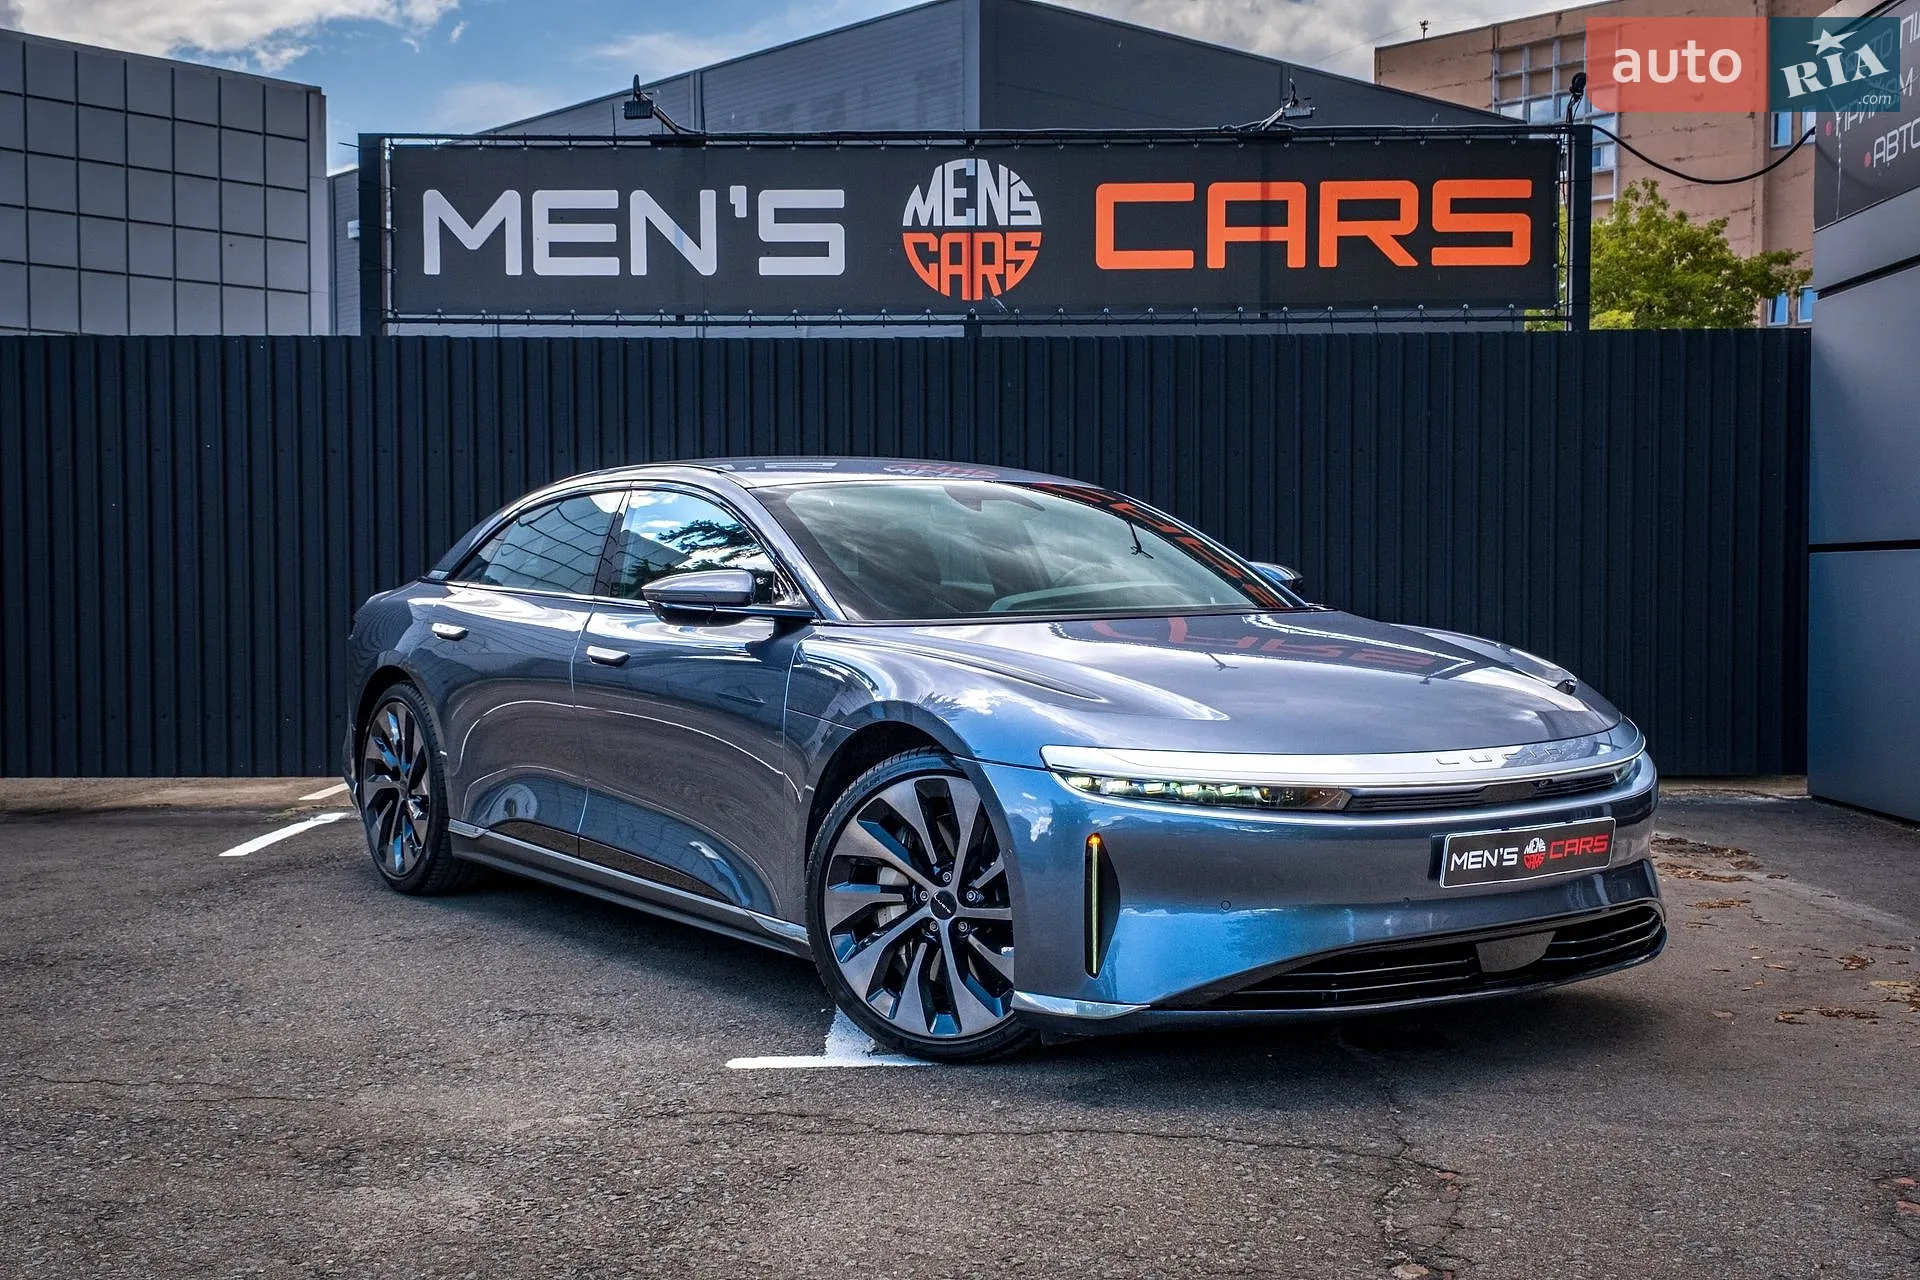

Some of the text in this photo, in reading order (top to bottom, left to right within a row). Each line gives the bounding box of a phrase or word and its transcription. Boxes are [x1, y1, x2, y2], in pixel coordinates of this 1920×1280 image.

[902, 158, 1042, 227] MEN'S
[423, 179, 1532, 276] MEN'S CARS
[902, 231, 1042, 301] CARS
[1450, 835, 1609, 872] MEN'S CARS
